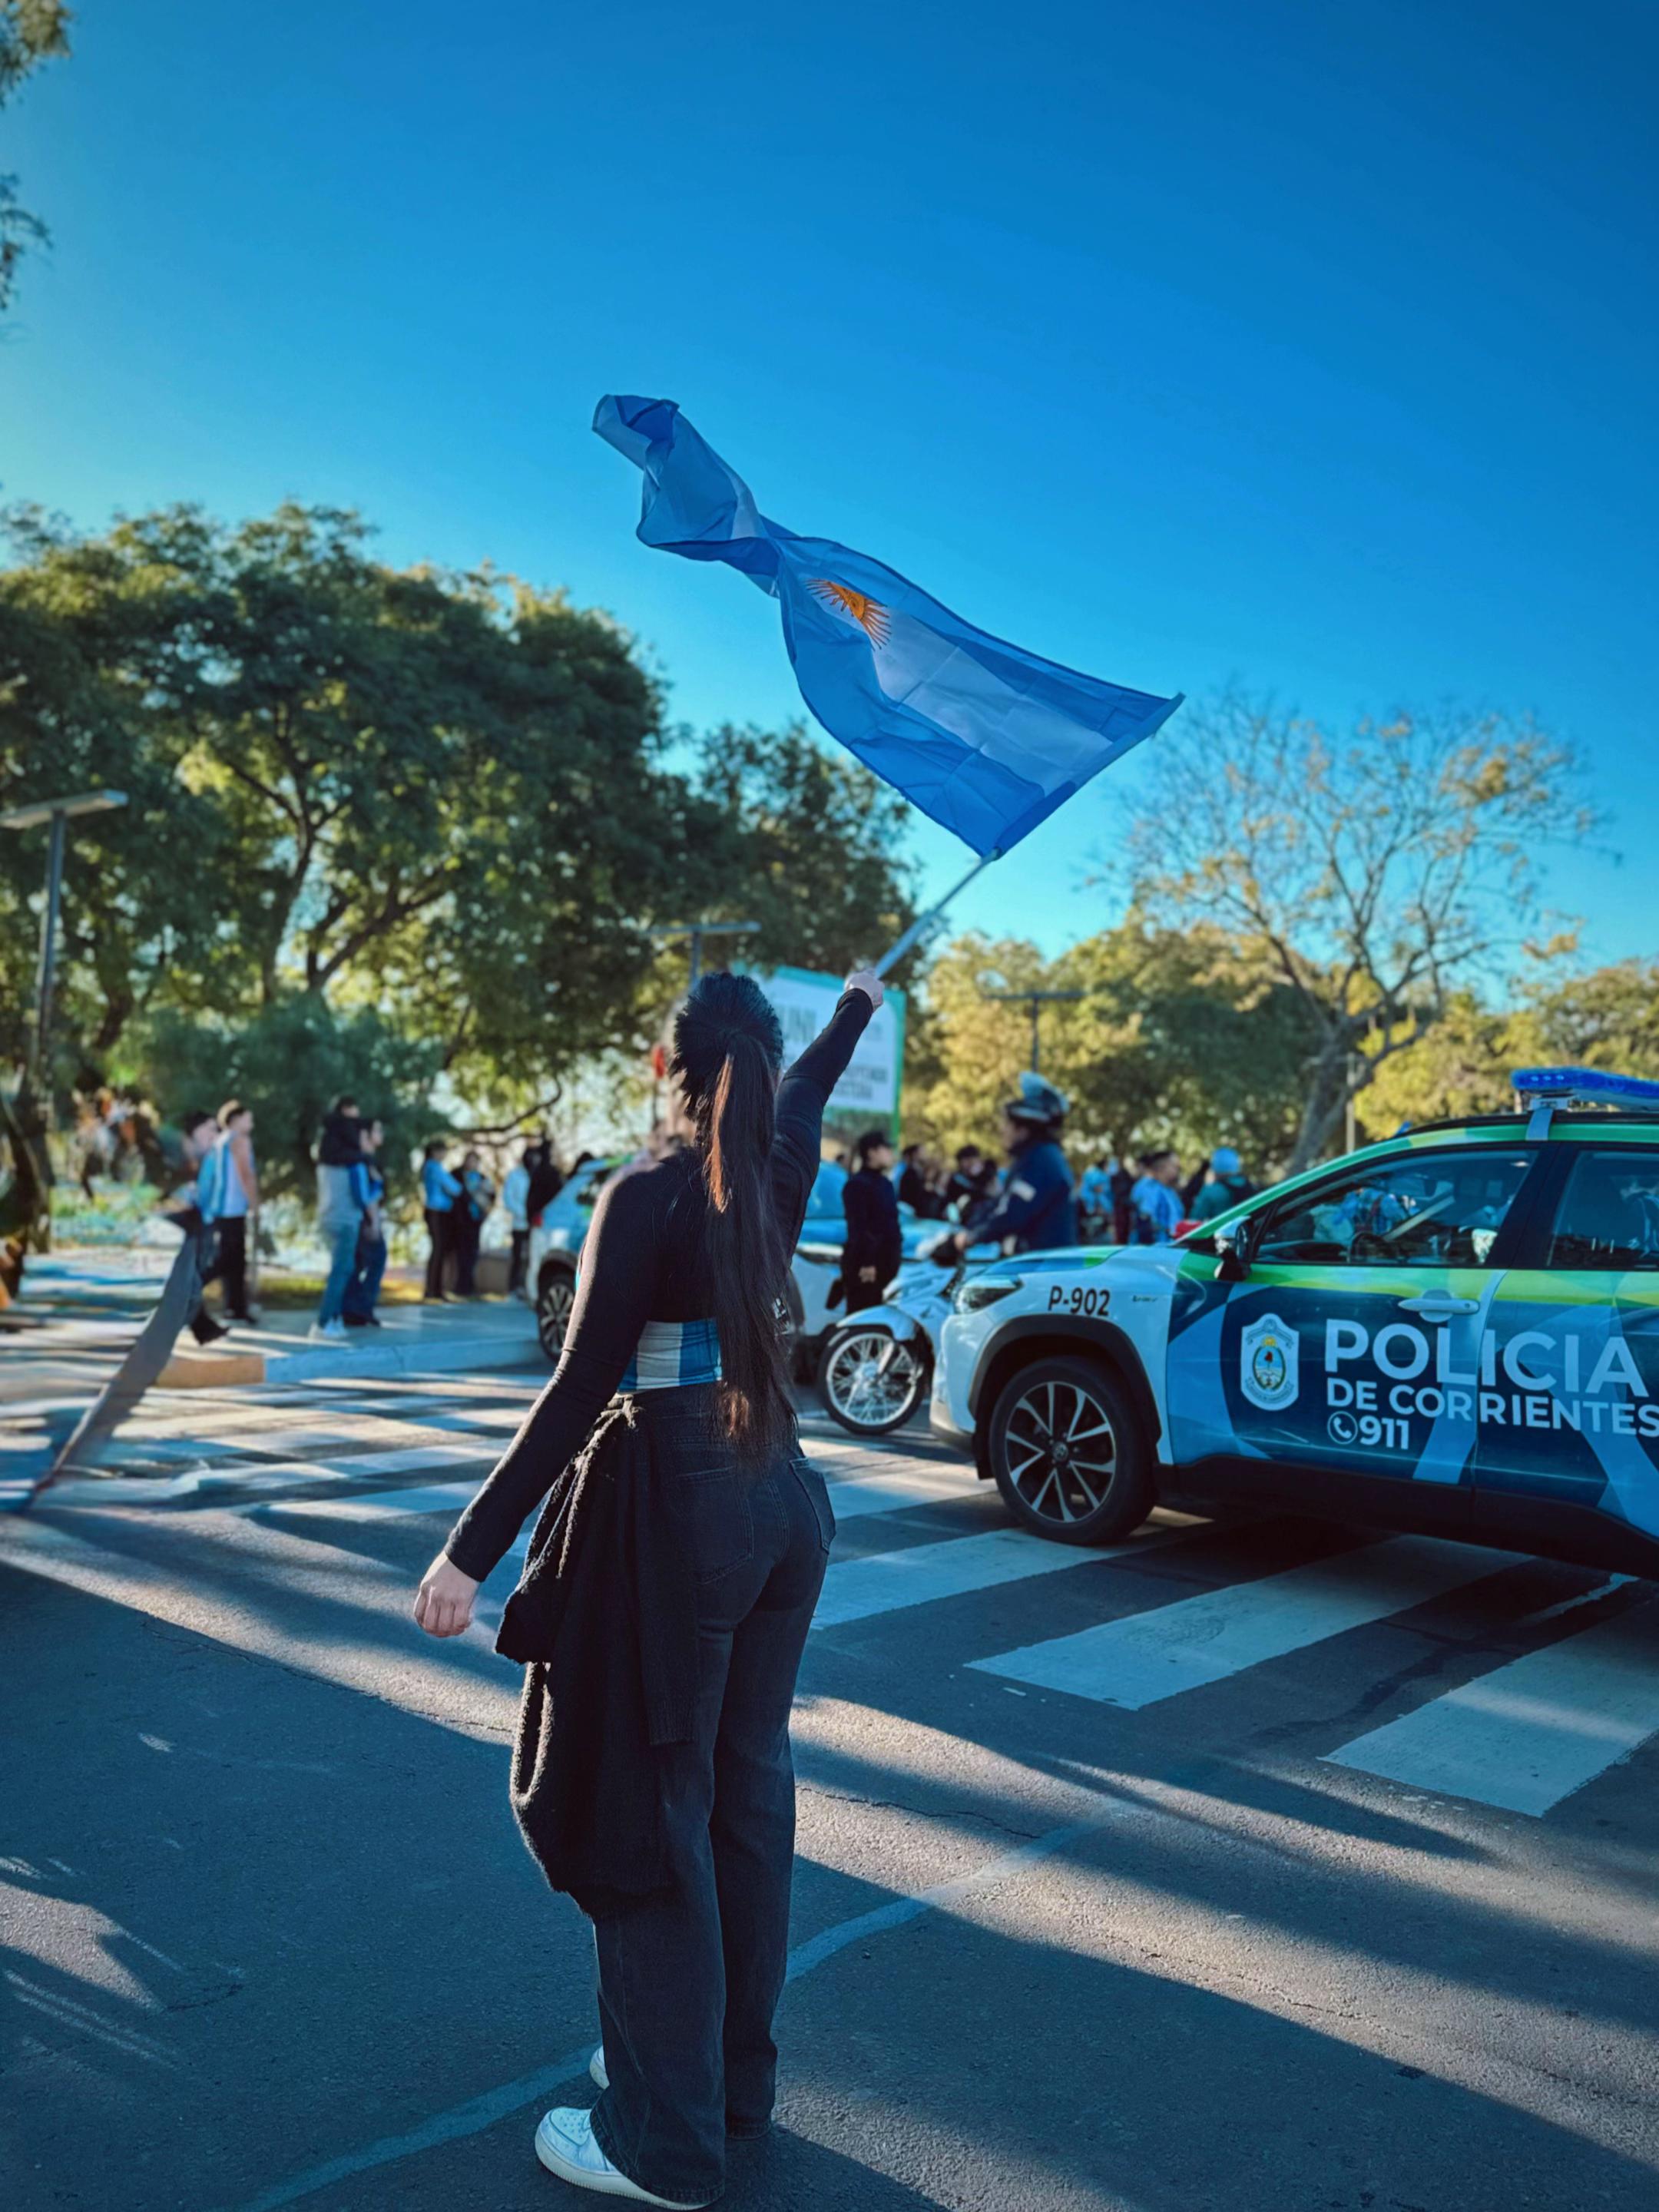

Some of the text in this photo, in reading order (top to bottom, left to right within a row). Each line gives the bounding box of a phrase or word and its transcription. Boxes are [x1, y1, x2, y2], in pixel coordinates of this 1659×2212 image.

[1048, 1285, 1111, 1316] P-902
[1325, 1319, 1649, 1398] POLICIA
[1327, 1377, 1378, 1411] DE
[1389, 1384, 1659, 1438] CORRIENTES
[1359, 1415, 1409, 1450] 911
